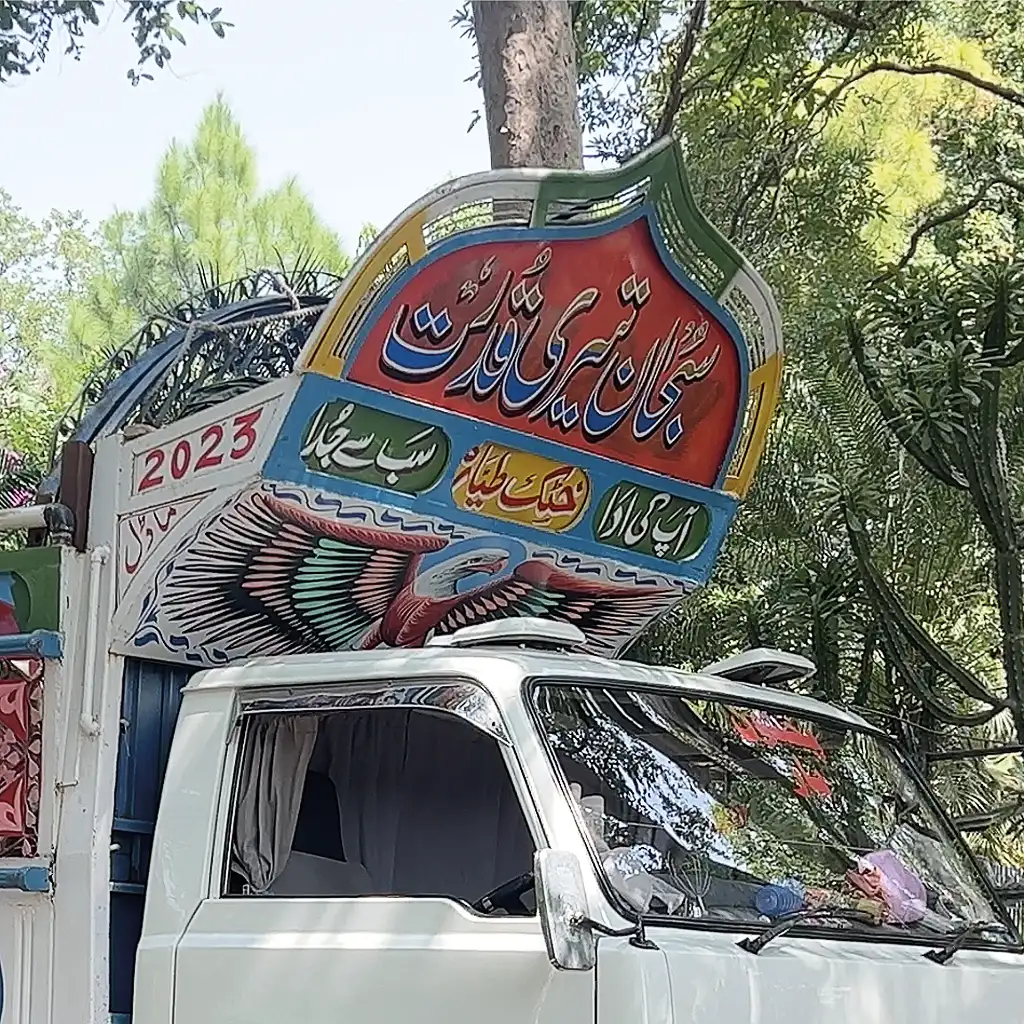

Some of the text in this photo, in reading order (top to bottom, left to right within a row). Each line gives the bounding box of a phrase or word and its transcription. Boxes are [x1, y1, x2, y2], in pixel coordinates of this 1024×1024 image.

[137, 407, 263, 493] 2023
[331, 432, 376, 469] سے
[124, 505, 177, 575] ماڈل
[651, 504, 701, 558] آپ
